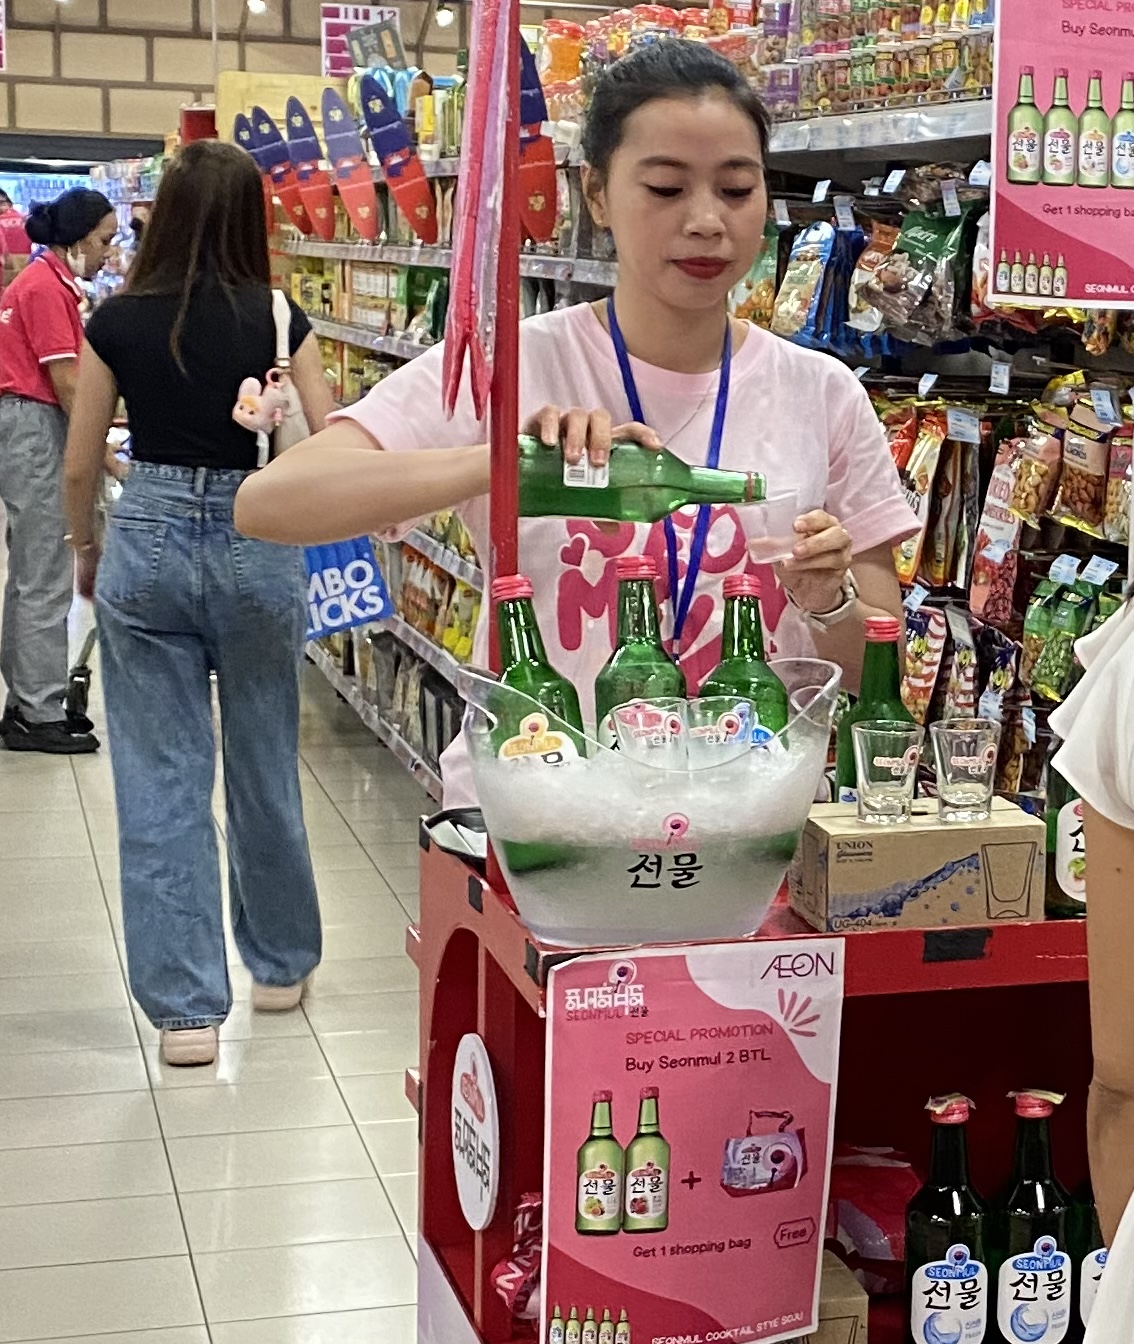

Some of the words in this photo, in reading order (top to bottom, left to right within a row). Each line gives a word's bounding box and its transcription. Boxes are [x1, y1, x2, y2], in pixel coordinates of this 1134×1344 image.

[1061, 20, 1085, 37] Buy
[1042, 203, 1063, 216] Get
[1066, 205, 1071, 215] 1
[1074, 205, 1120, 219] shopping
[309, 560, 374, 602] MBO
[309, 585, 384, 631] ICKS
[626, 853, 704, 889] 선물
[625, 1029, 686, 1045] SPECIAL
[689, 1021, 774, 1042] PROMOTION
[625, 1056, 655, 1073] Buy
[658, 1050, 722, 1070] Seonmul
[725, 1051, 735, 1065] 2
[739, 1048, 772, 1064] BTL
[780, 1226, 807, 1242] Free
[633, 1245, 656, 1258] Get
[659, 1244, 665, 1257] 1
[669, 1240, 725, 1259] shopping
[728, 1237, 752, 1253] bag
[922, 1278, 982, 1311] 선물
[1009, 1269, 1067, 1302] 선물
